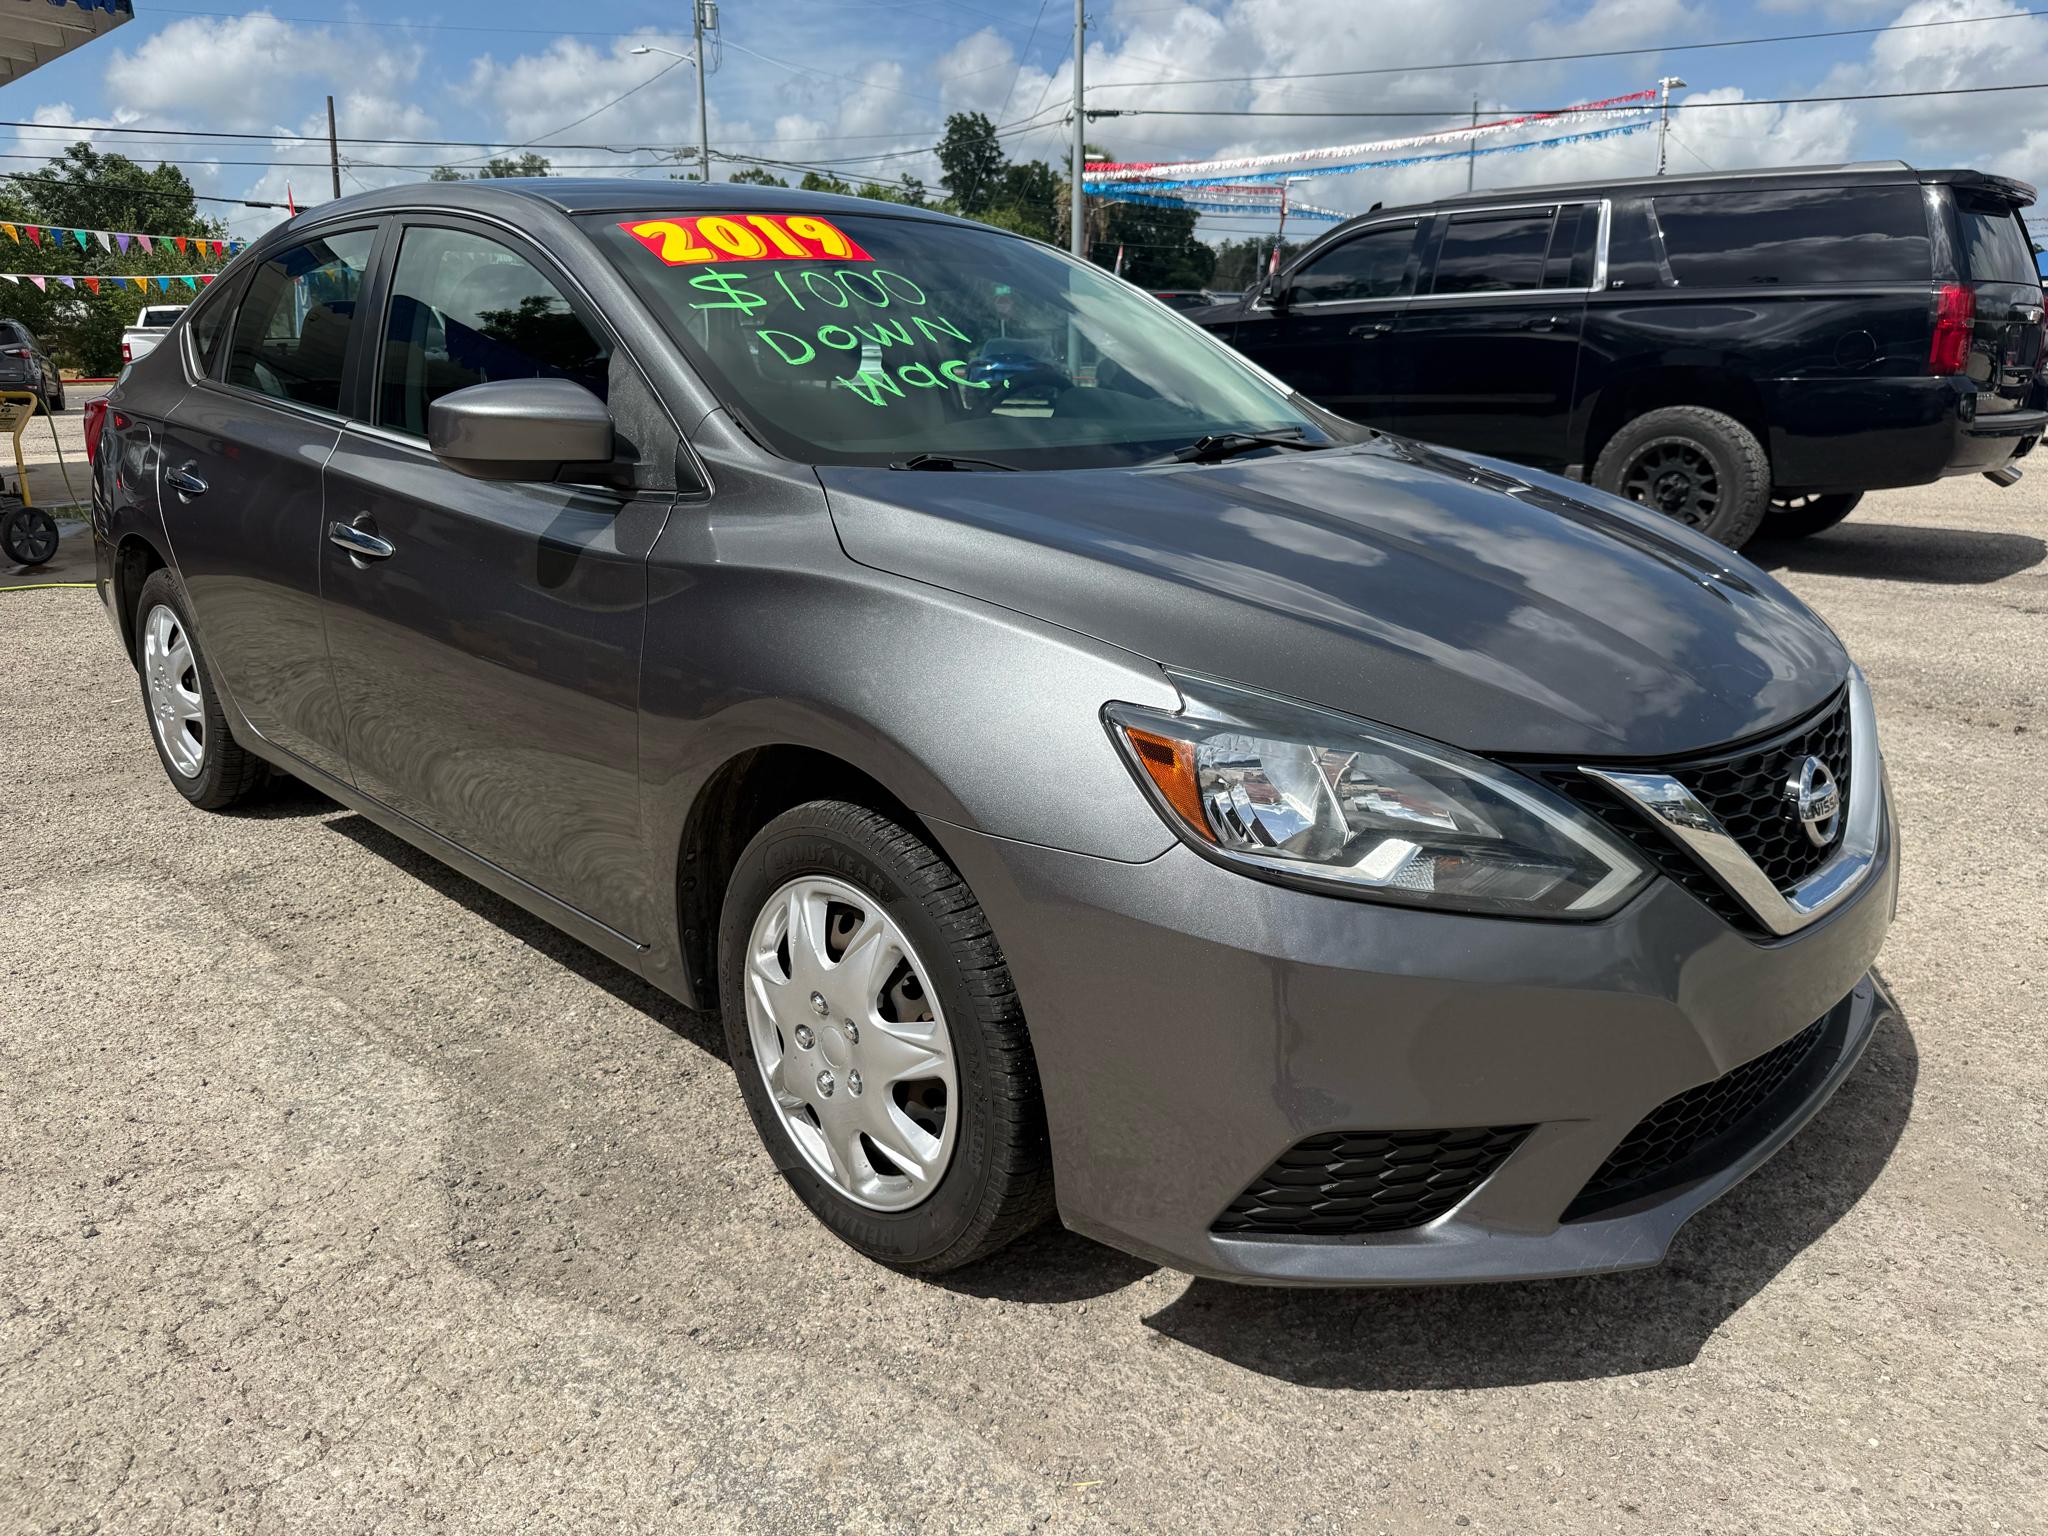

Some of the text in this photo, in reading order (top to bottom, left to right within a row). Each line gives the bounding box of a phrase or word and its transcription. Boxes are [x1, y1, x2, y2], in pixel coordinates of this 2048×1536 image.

[632, 215, 852, 261] 2019
[688, 267, 926, 316] $1000
[756, 315, 973, 366] DOWN
